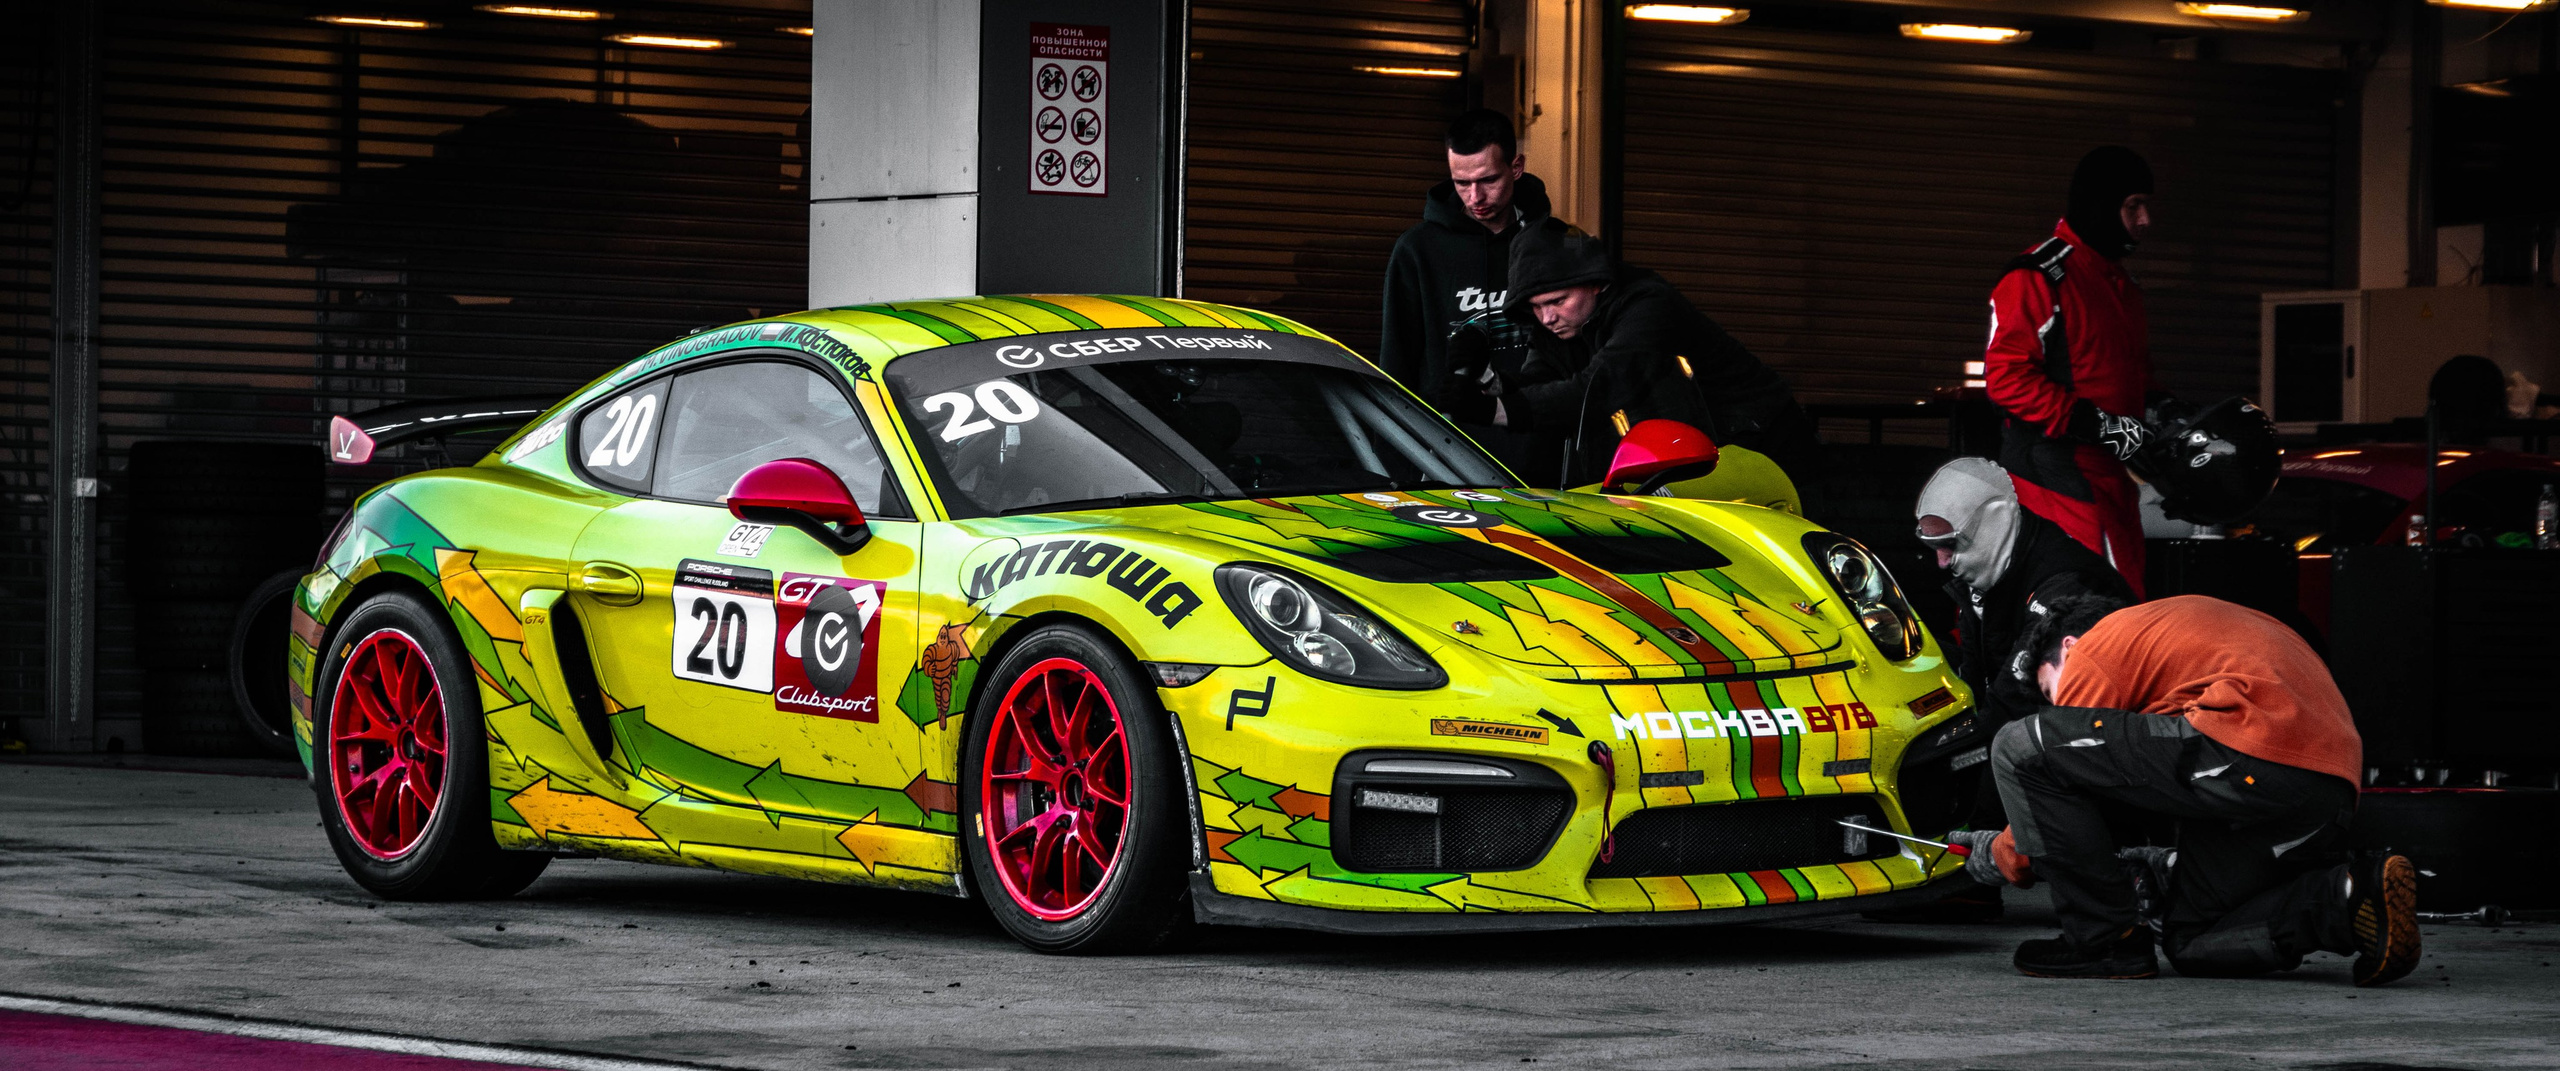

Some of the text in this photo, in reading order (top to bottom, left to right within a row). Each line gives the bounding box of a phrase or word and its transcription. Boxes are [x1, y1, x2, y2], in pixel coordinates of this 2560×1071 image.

[1032, 35, 1107, 48] ПОВЫШЕННОЙ
[1056, 27, 1084, 37] ЗОНА
[1039, 45, 1103, 57] ОПАСНОСТИ
[1048, 334, 1272, 359] СБЕР Первый
[923, 380, 1040, 443] 20
[587, 394, 657, 467] 20
[686, 562, 733, 576] PORSCHE
[967, 539, 1204, 630] КАТЮША
[525, 615, 546, 625] GT4
[686, 596, 748, 680] 20
[776, 685, 875, 713] Clubsport
[1461, 724, 1542, 739] MICHELIN
[1609, 707, 1808, 740] МОСКВА
